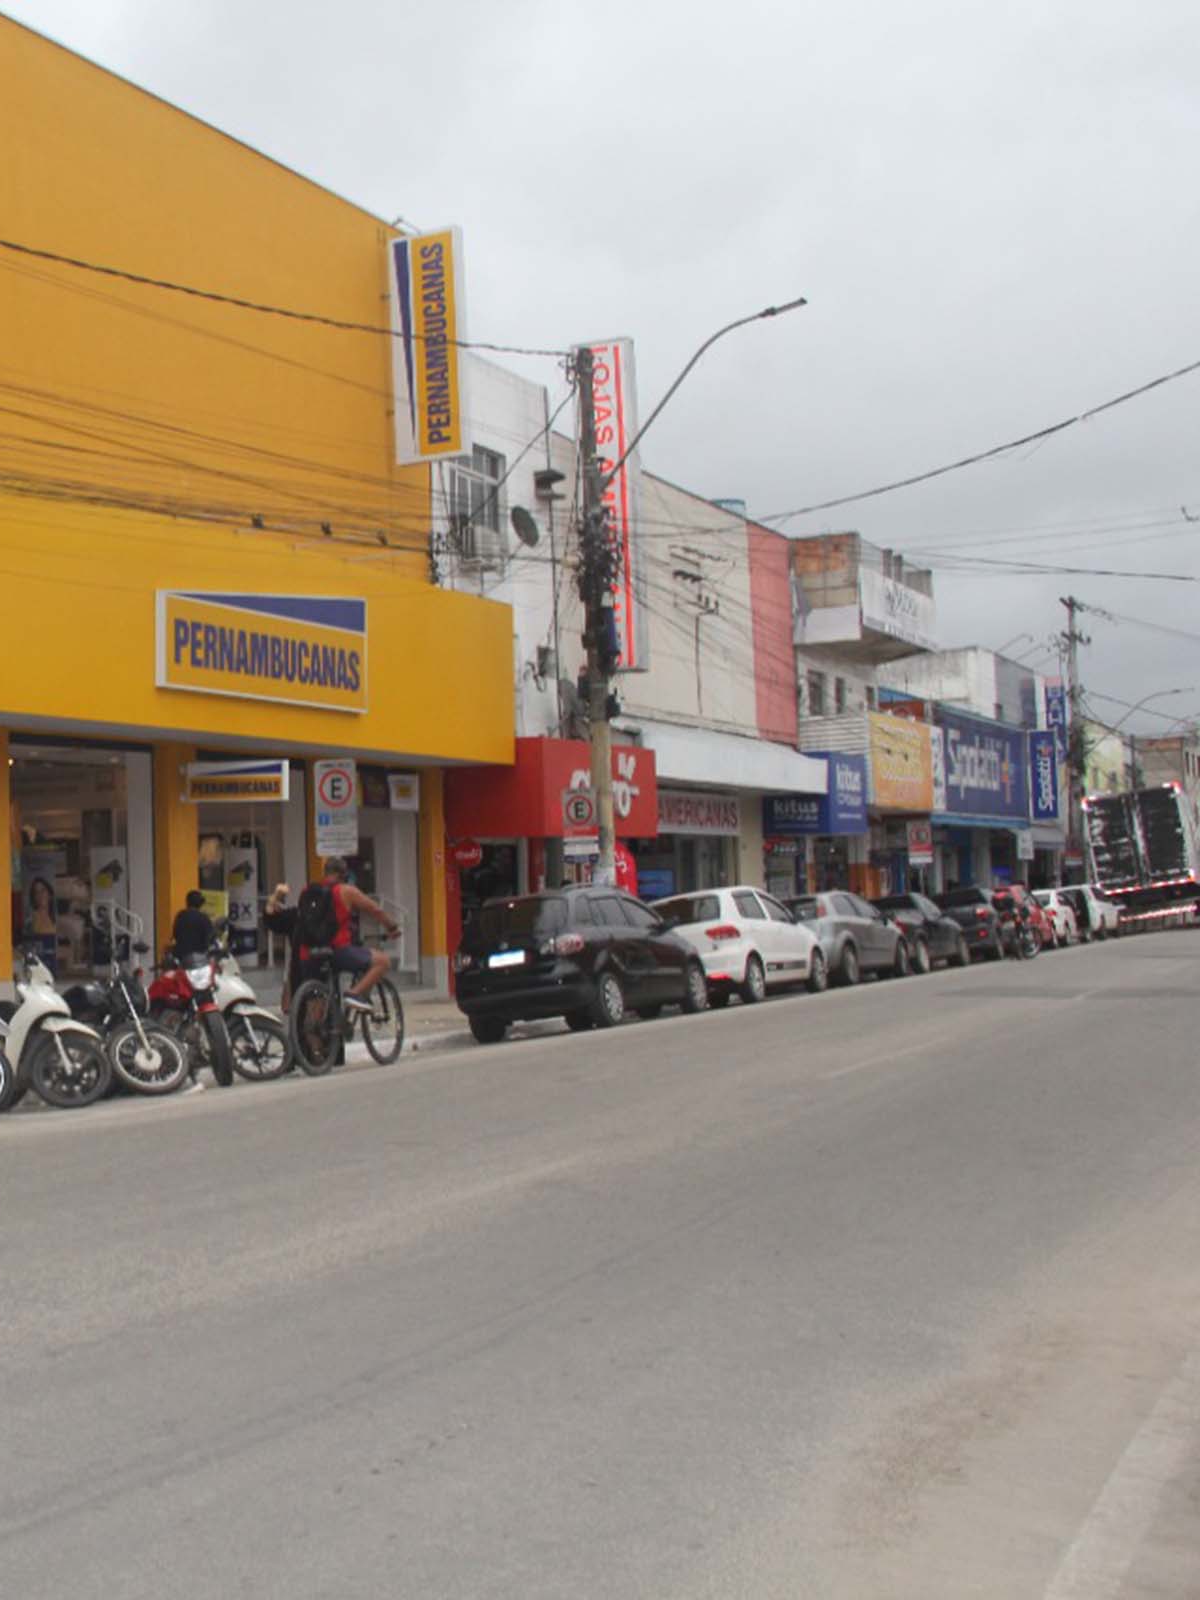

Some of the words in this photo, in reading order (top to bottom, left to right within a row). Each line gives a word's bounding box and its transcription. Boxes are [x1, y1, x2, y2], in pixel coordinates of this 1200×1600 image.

[419, 241, 451, 446] PERNAMBUCANAS
[173, 617, 360, 692] PERNAMBUCANAS
[330, 777, 343, 800] E
[573, 801, 585, 819] E
